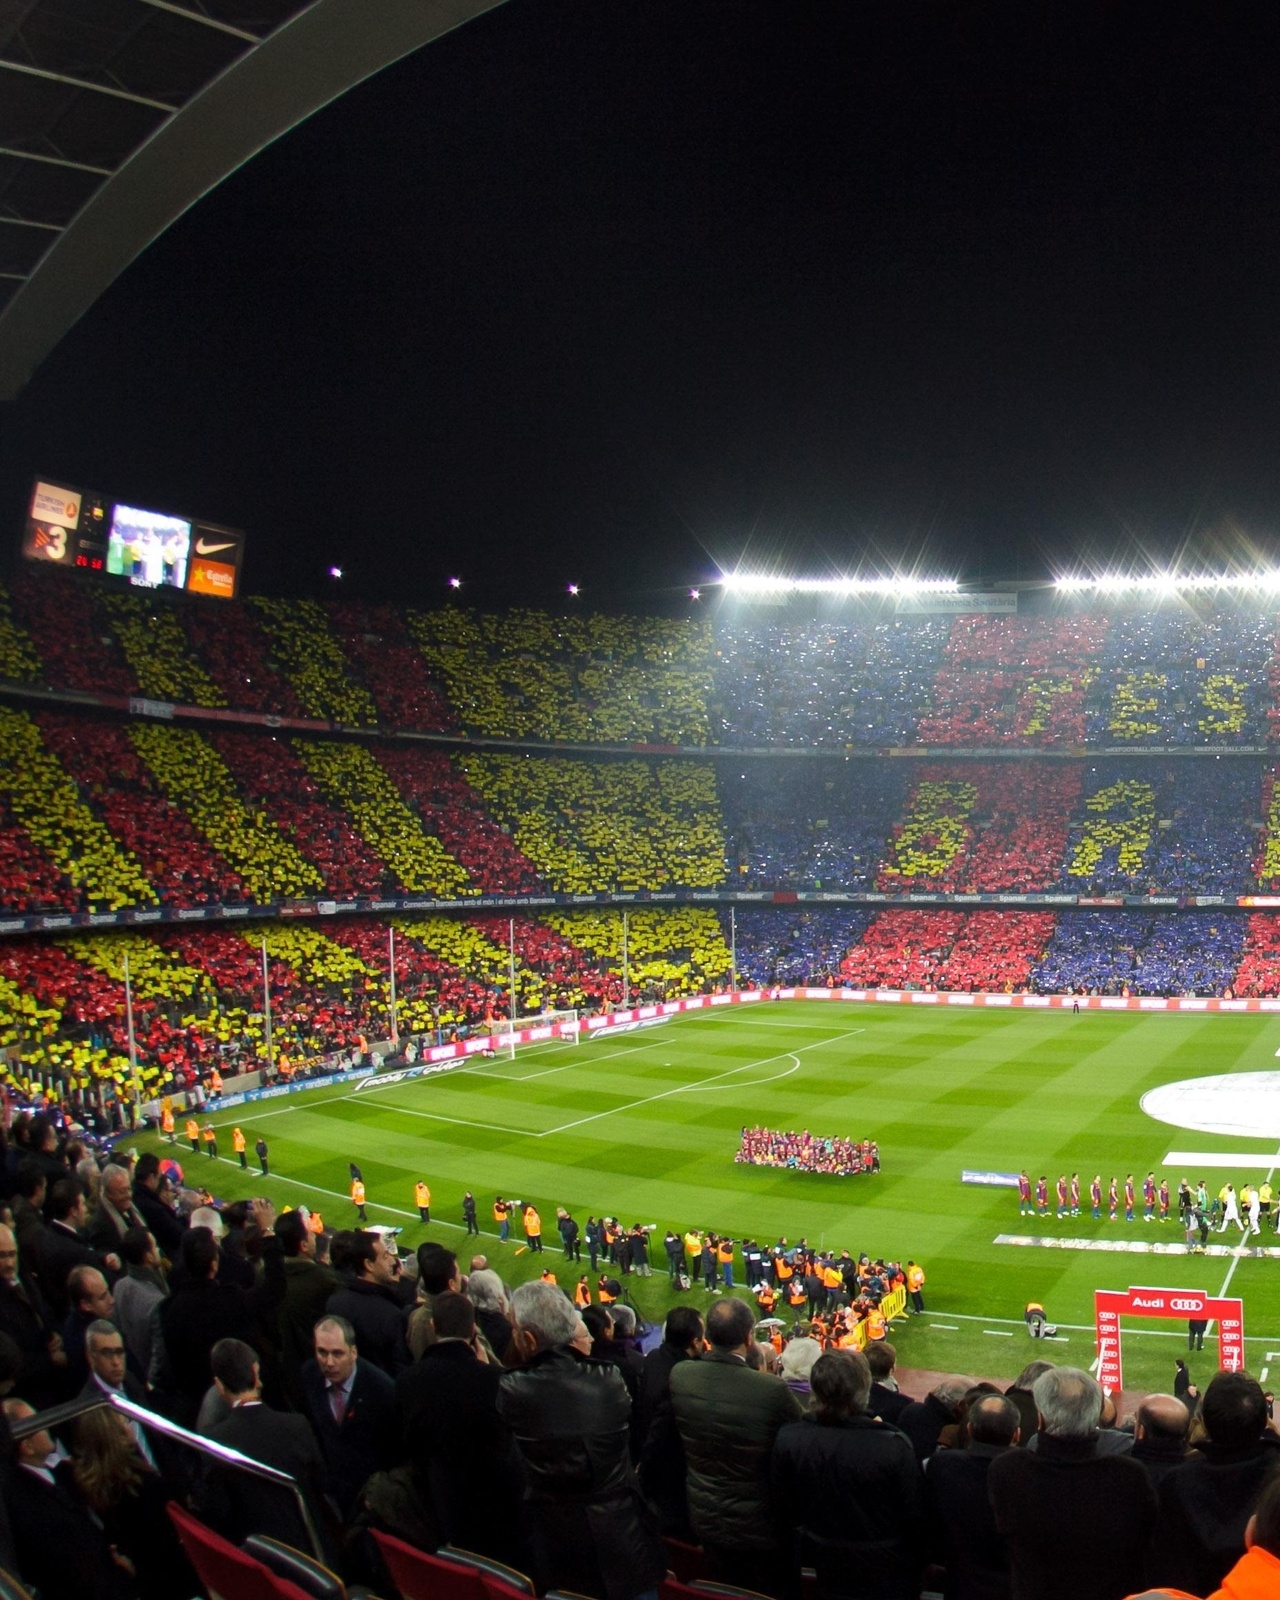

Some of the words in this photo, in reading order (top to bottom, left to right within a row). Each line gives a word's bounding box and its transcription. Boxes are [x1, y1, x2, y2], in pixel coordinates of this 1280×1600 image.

[46, 526, 67, 559] 3
[130, 577, 158, 589] SONY
[1149, 896, 1178, 905] Spanair
[1132, 1297, 1165, 1309] Audi
